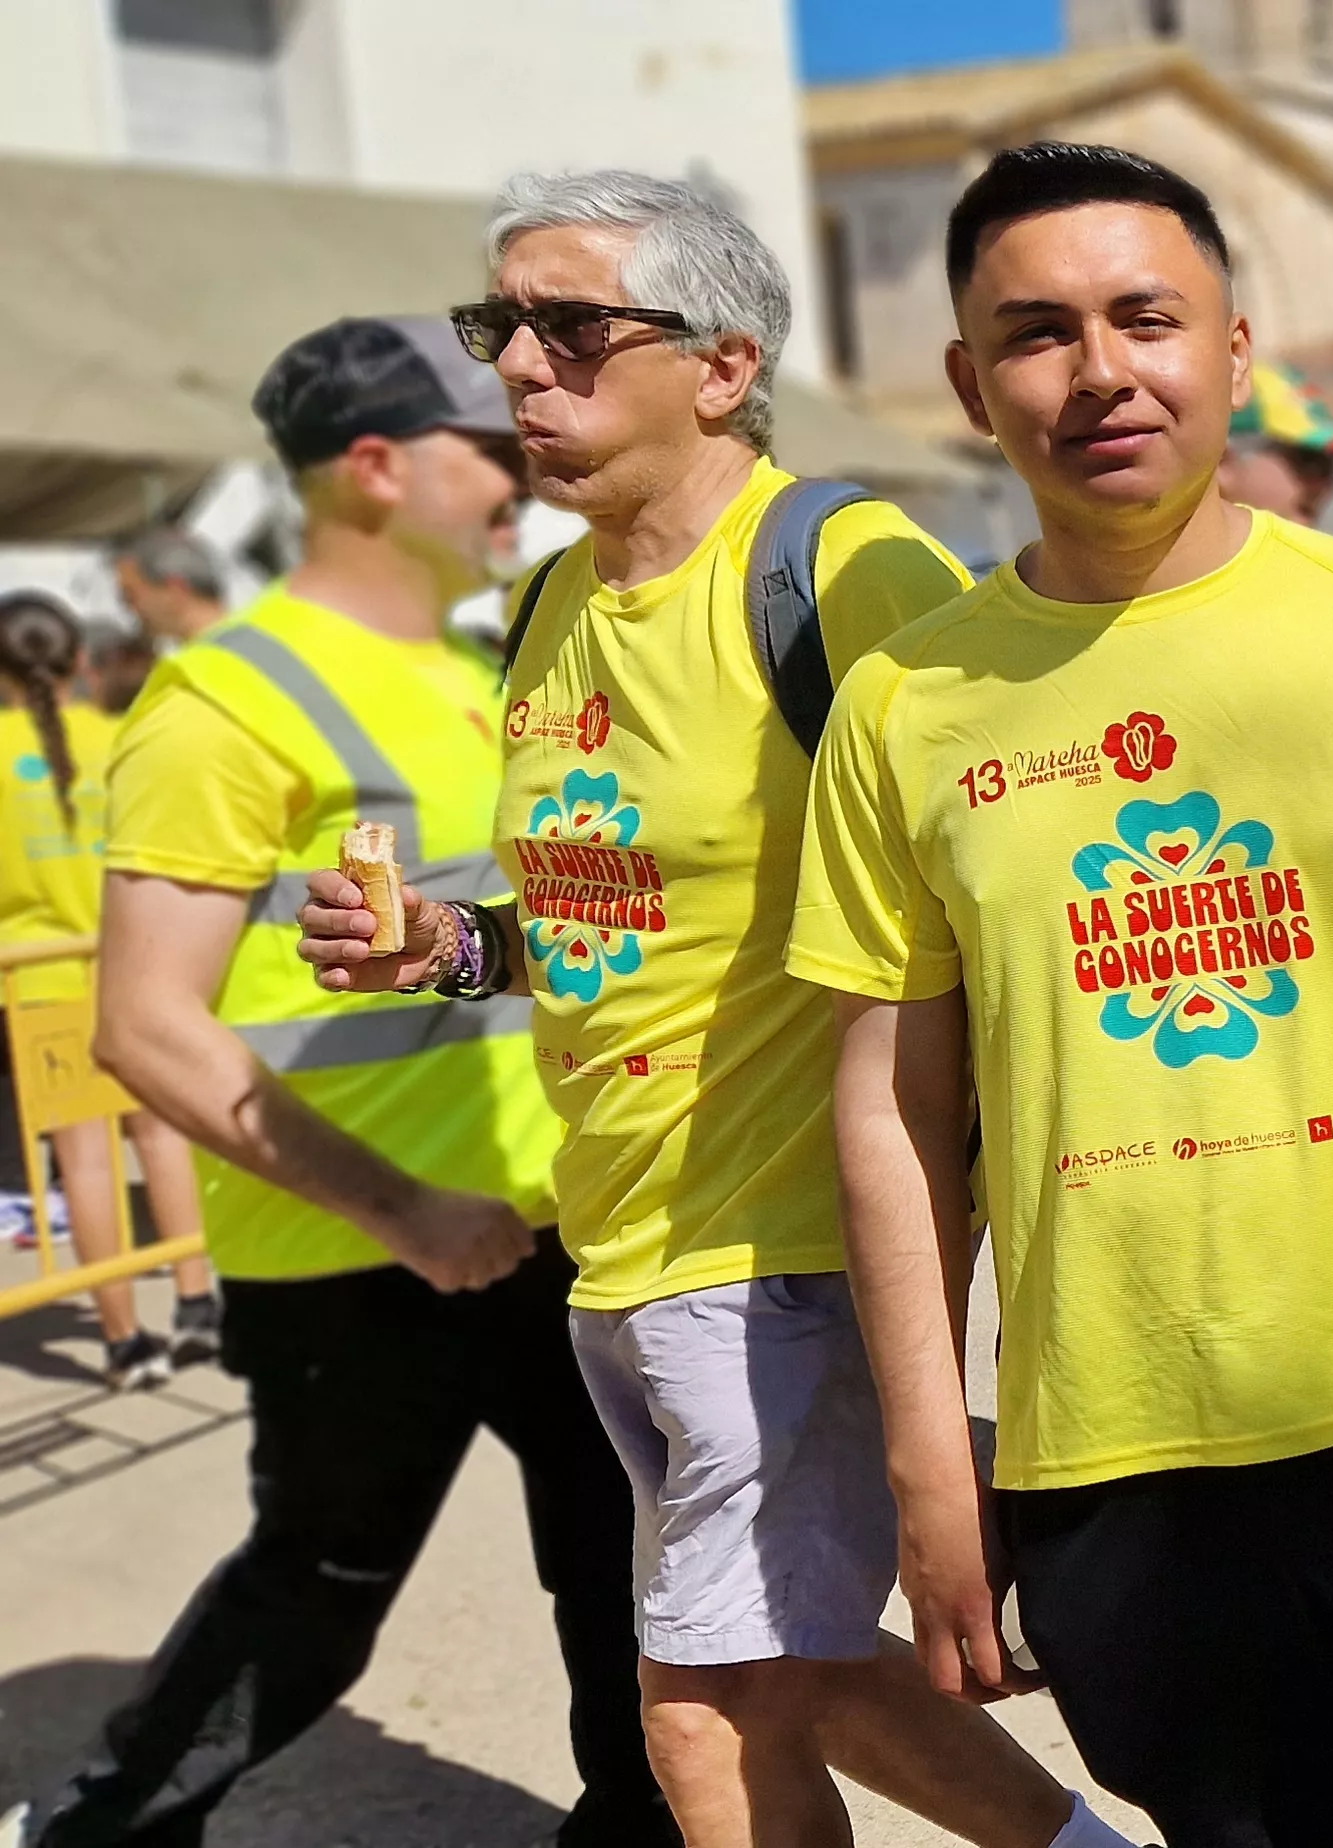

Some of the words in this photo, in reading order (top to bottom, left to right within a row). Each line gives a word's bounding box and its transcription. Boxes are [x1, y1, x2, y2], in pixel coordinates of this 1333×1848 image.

[1013, 740, 1099, 776] Marcha
[1017, 772, 1056, 789] ASPACE
[1059, 762, 1102, 779] HUESCA
[1075, 775, 1102, 788] 2025
[515, 838, 549, 875] LA
[543, 841, 629, 886] SUERTE
[628, 850, 663, 891] DE
[523, 876, 667, 932] CONOCERNOS
[1066, 897, 1119, 946] LA
[1124, 875, 1256, 936] SUERTE
[1263, 868, 1305, 917] DE
[1074, 916, 1315, 993] CONOCERNOS
[662, 1063, 697, 1071] Huesca
[1072, 1141, 1157, 1169] ASPACE
[1200, 1139, 1232, 1152] hoya
[1233, 1135, 1249, 1147] de
[1250, 1129, 1296, 1144] huesca
